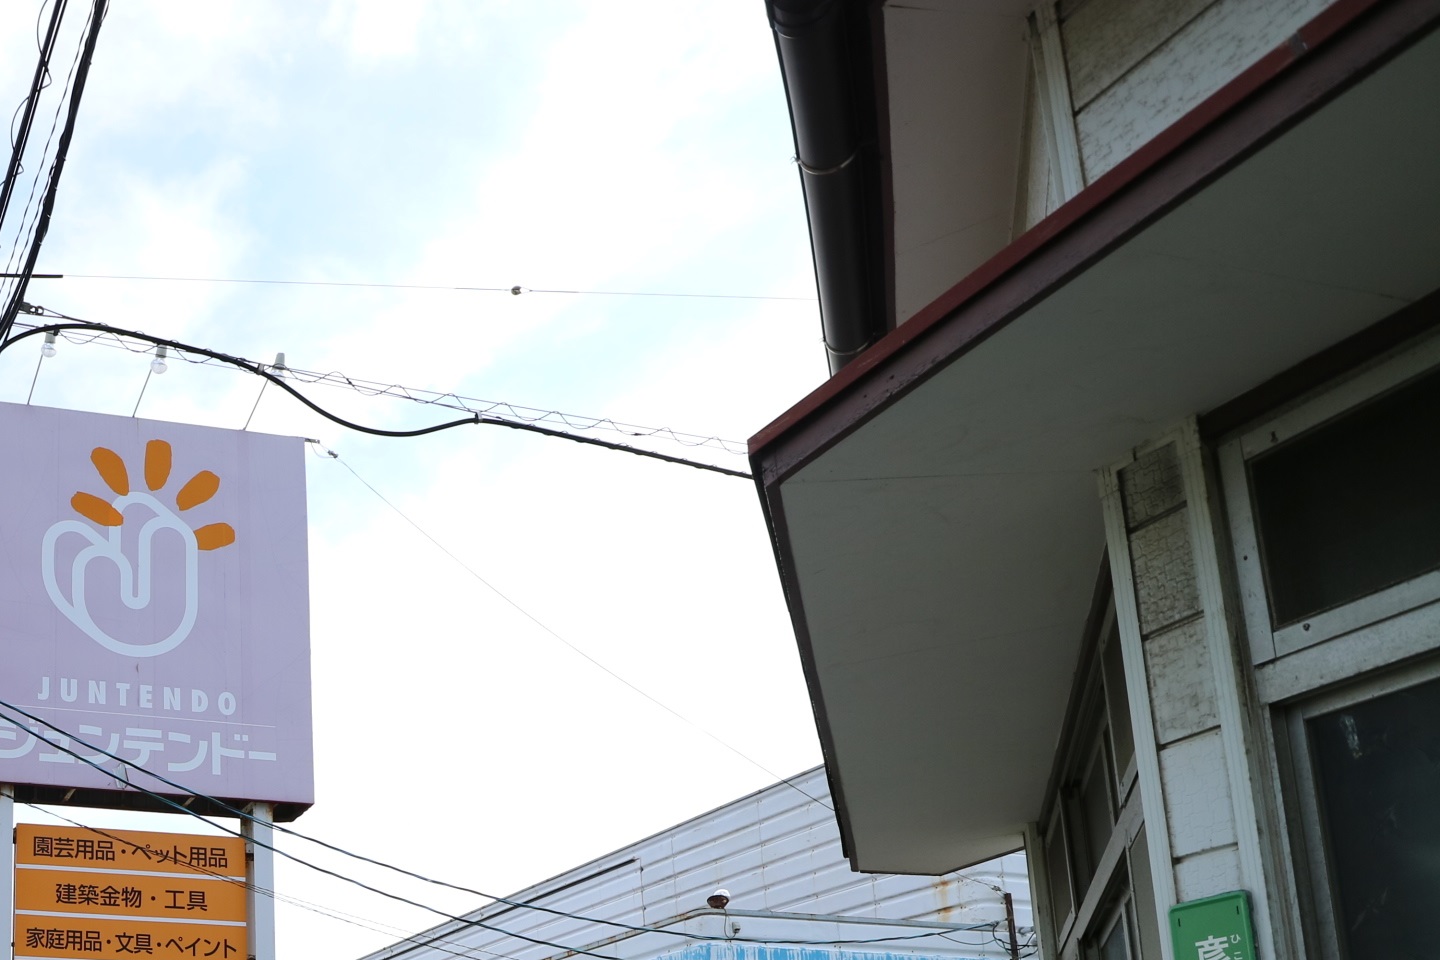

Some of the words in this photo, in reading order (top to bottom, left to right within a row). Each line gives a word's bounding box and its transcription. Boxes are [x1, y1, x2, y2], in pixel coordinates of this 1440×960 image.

[38, 676, 236, 716] JUNTENDO
[33, 835, 228, 869] 園芸用品・ペット用品
[55, 882, 208, 912] 建築金物・工具
[26, 927, 237, 959] 家庭用品・文具・ペイント
